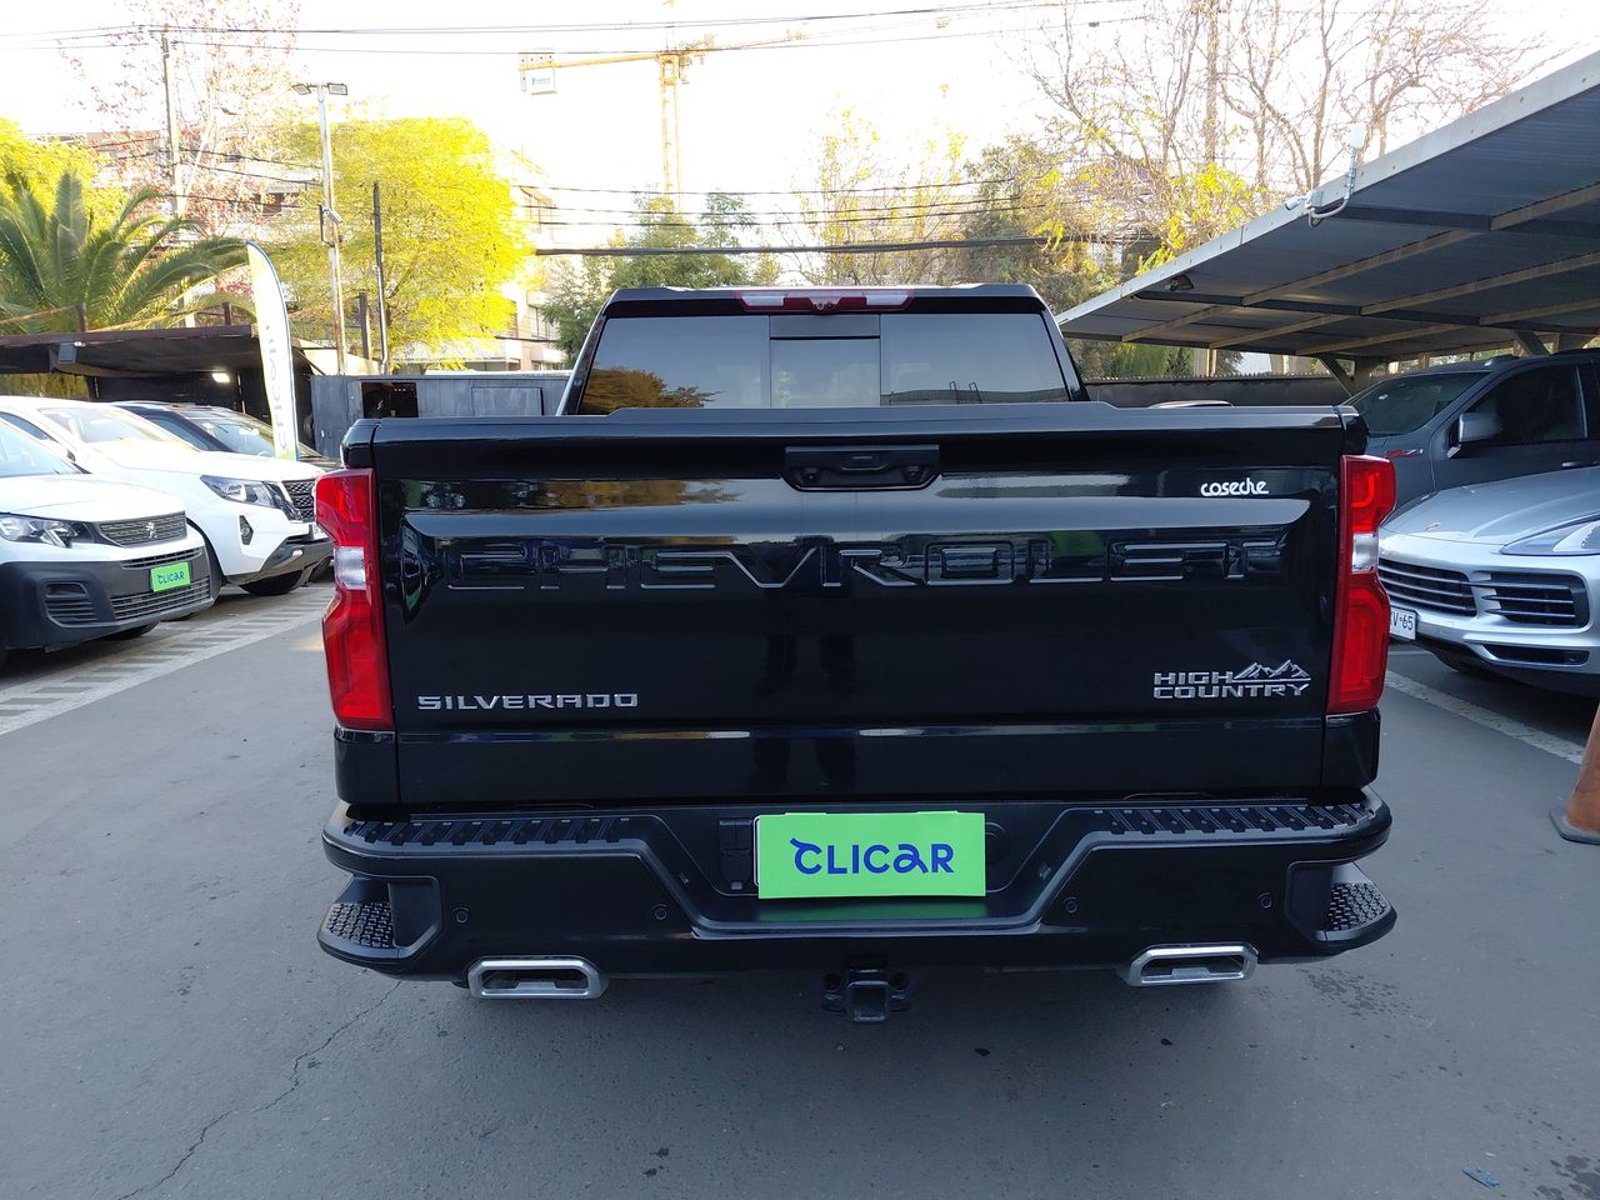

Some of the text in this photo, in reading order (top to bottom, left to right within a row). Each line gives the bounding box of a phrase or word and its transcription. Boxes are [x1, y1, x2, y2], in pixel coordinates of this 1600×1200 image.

[1200, 477, 1269, 497] coseche
[445, 539, 1285, 591] CHEVROLET
[1154, 671, 1233, 685] HIGH
[1153, 683, 1309, 699] COUNTRY
[418, 693, 638, 710] SILVERADO
[789, 837, 954, 874] CLICAR
